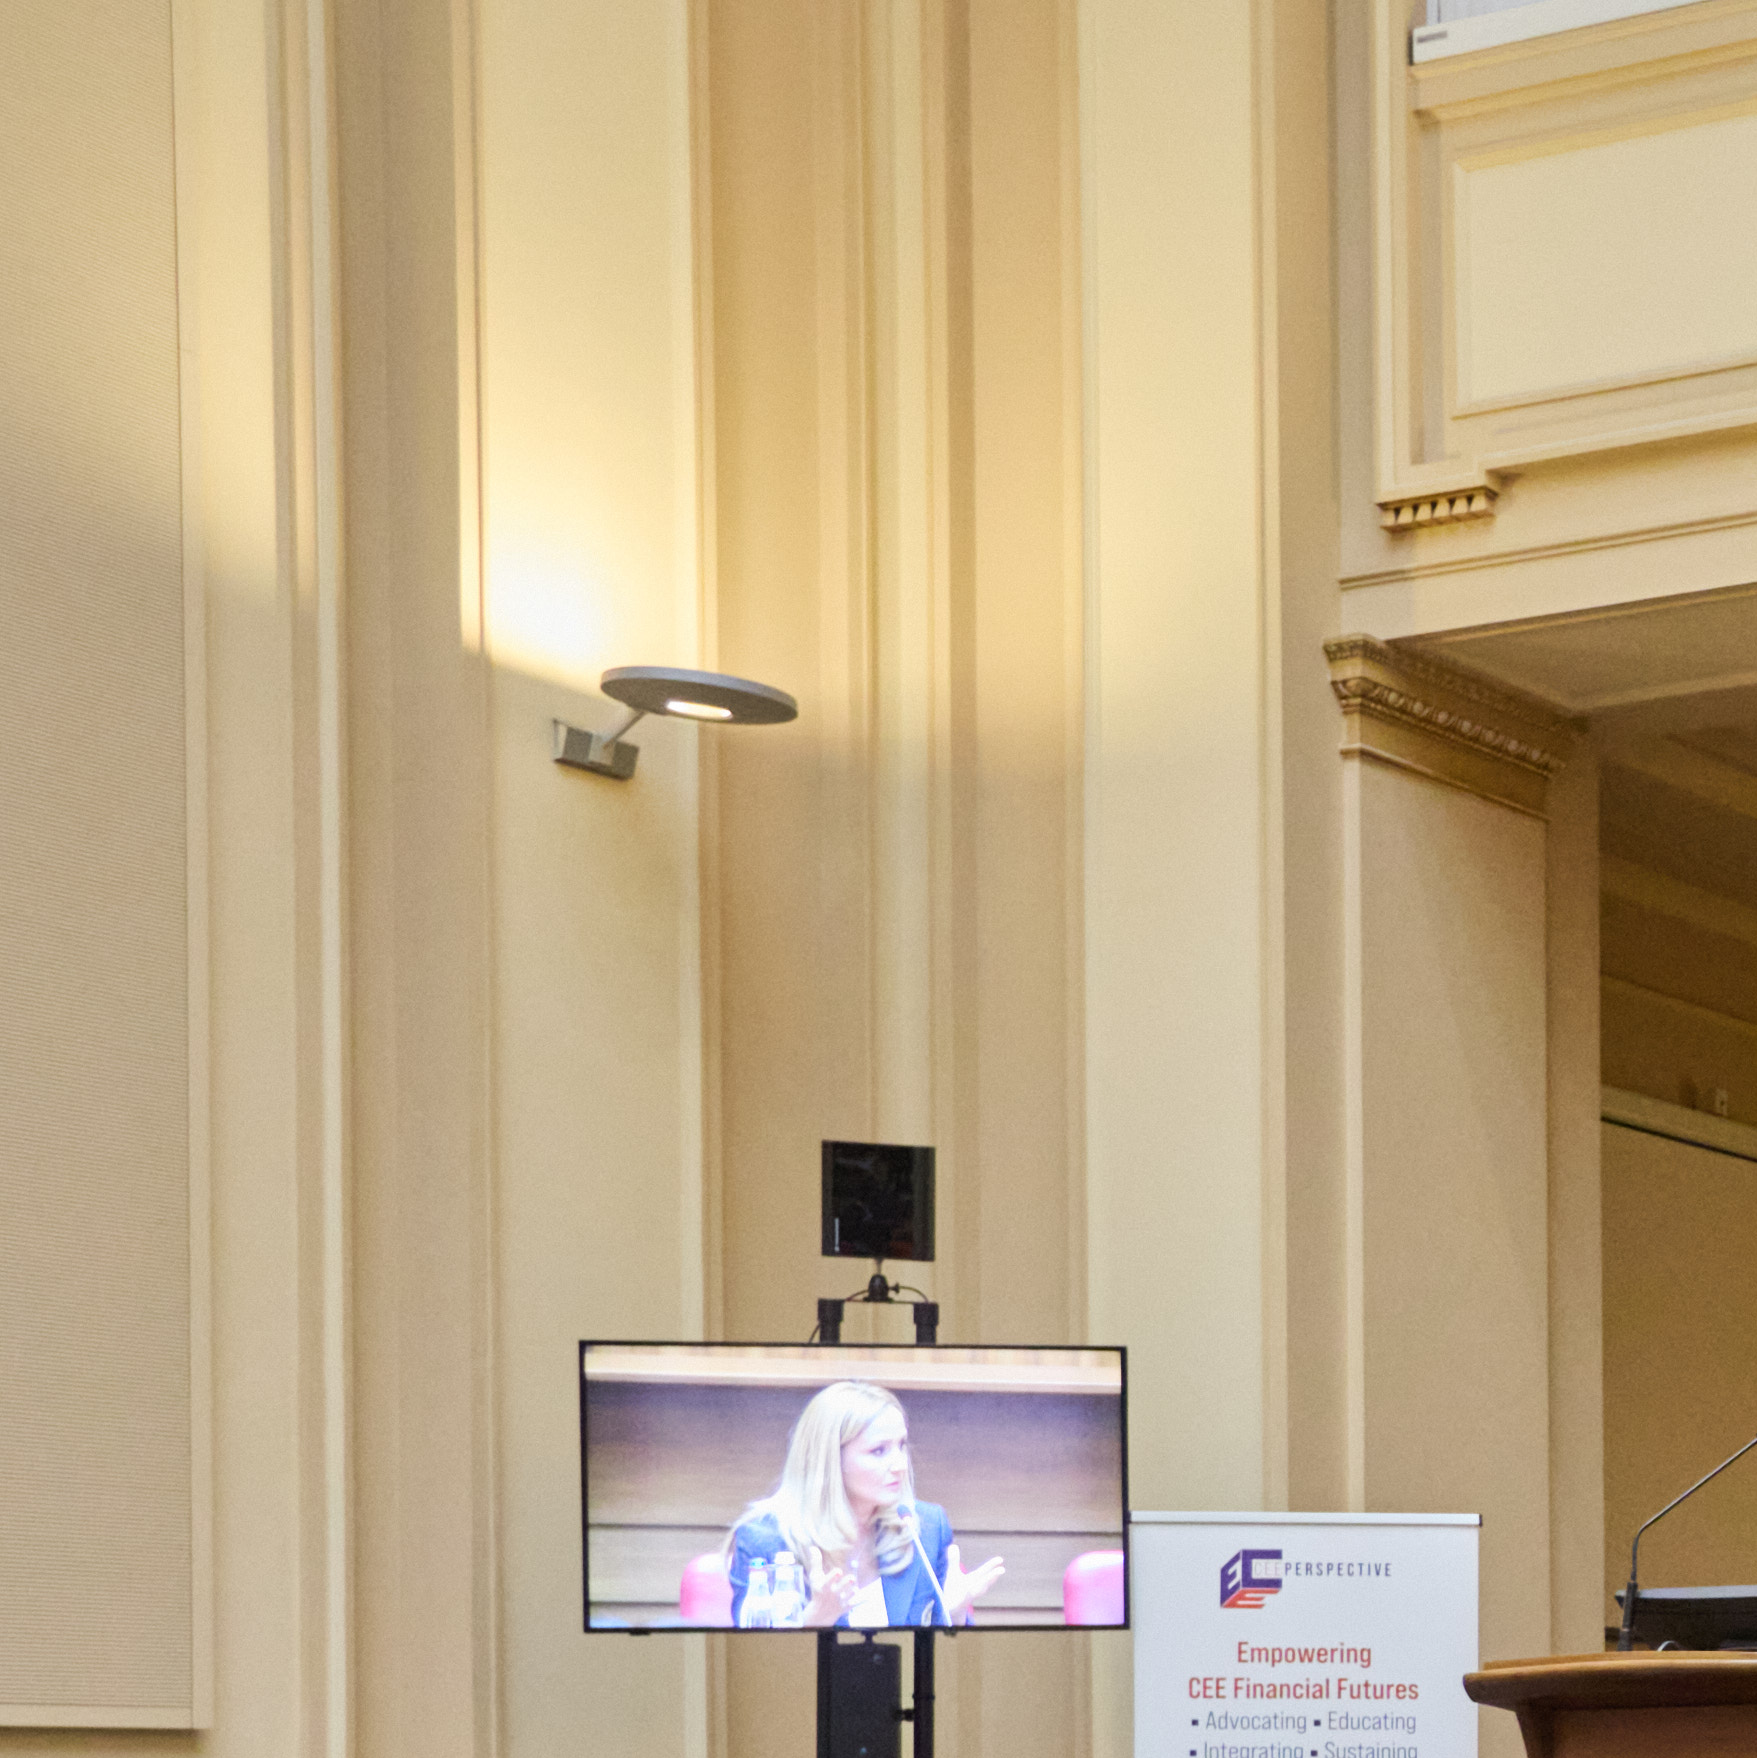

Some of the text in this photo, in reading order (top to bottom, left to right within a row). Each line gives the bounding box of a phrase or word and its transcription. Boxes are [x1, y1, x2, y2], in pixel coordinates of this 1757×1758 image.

[1285, 1562, 1392, 1577] PERSPECTIVE
[1237, 1641, 1372, 1668] Empowering
[1188, 1677, 1419, 1700] CEE Financial Futures
[1205, 1711, 1417, 1735] Advocating Educating
